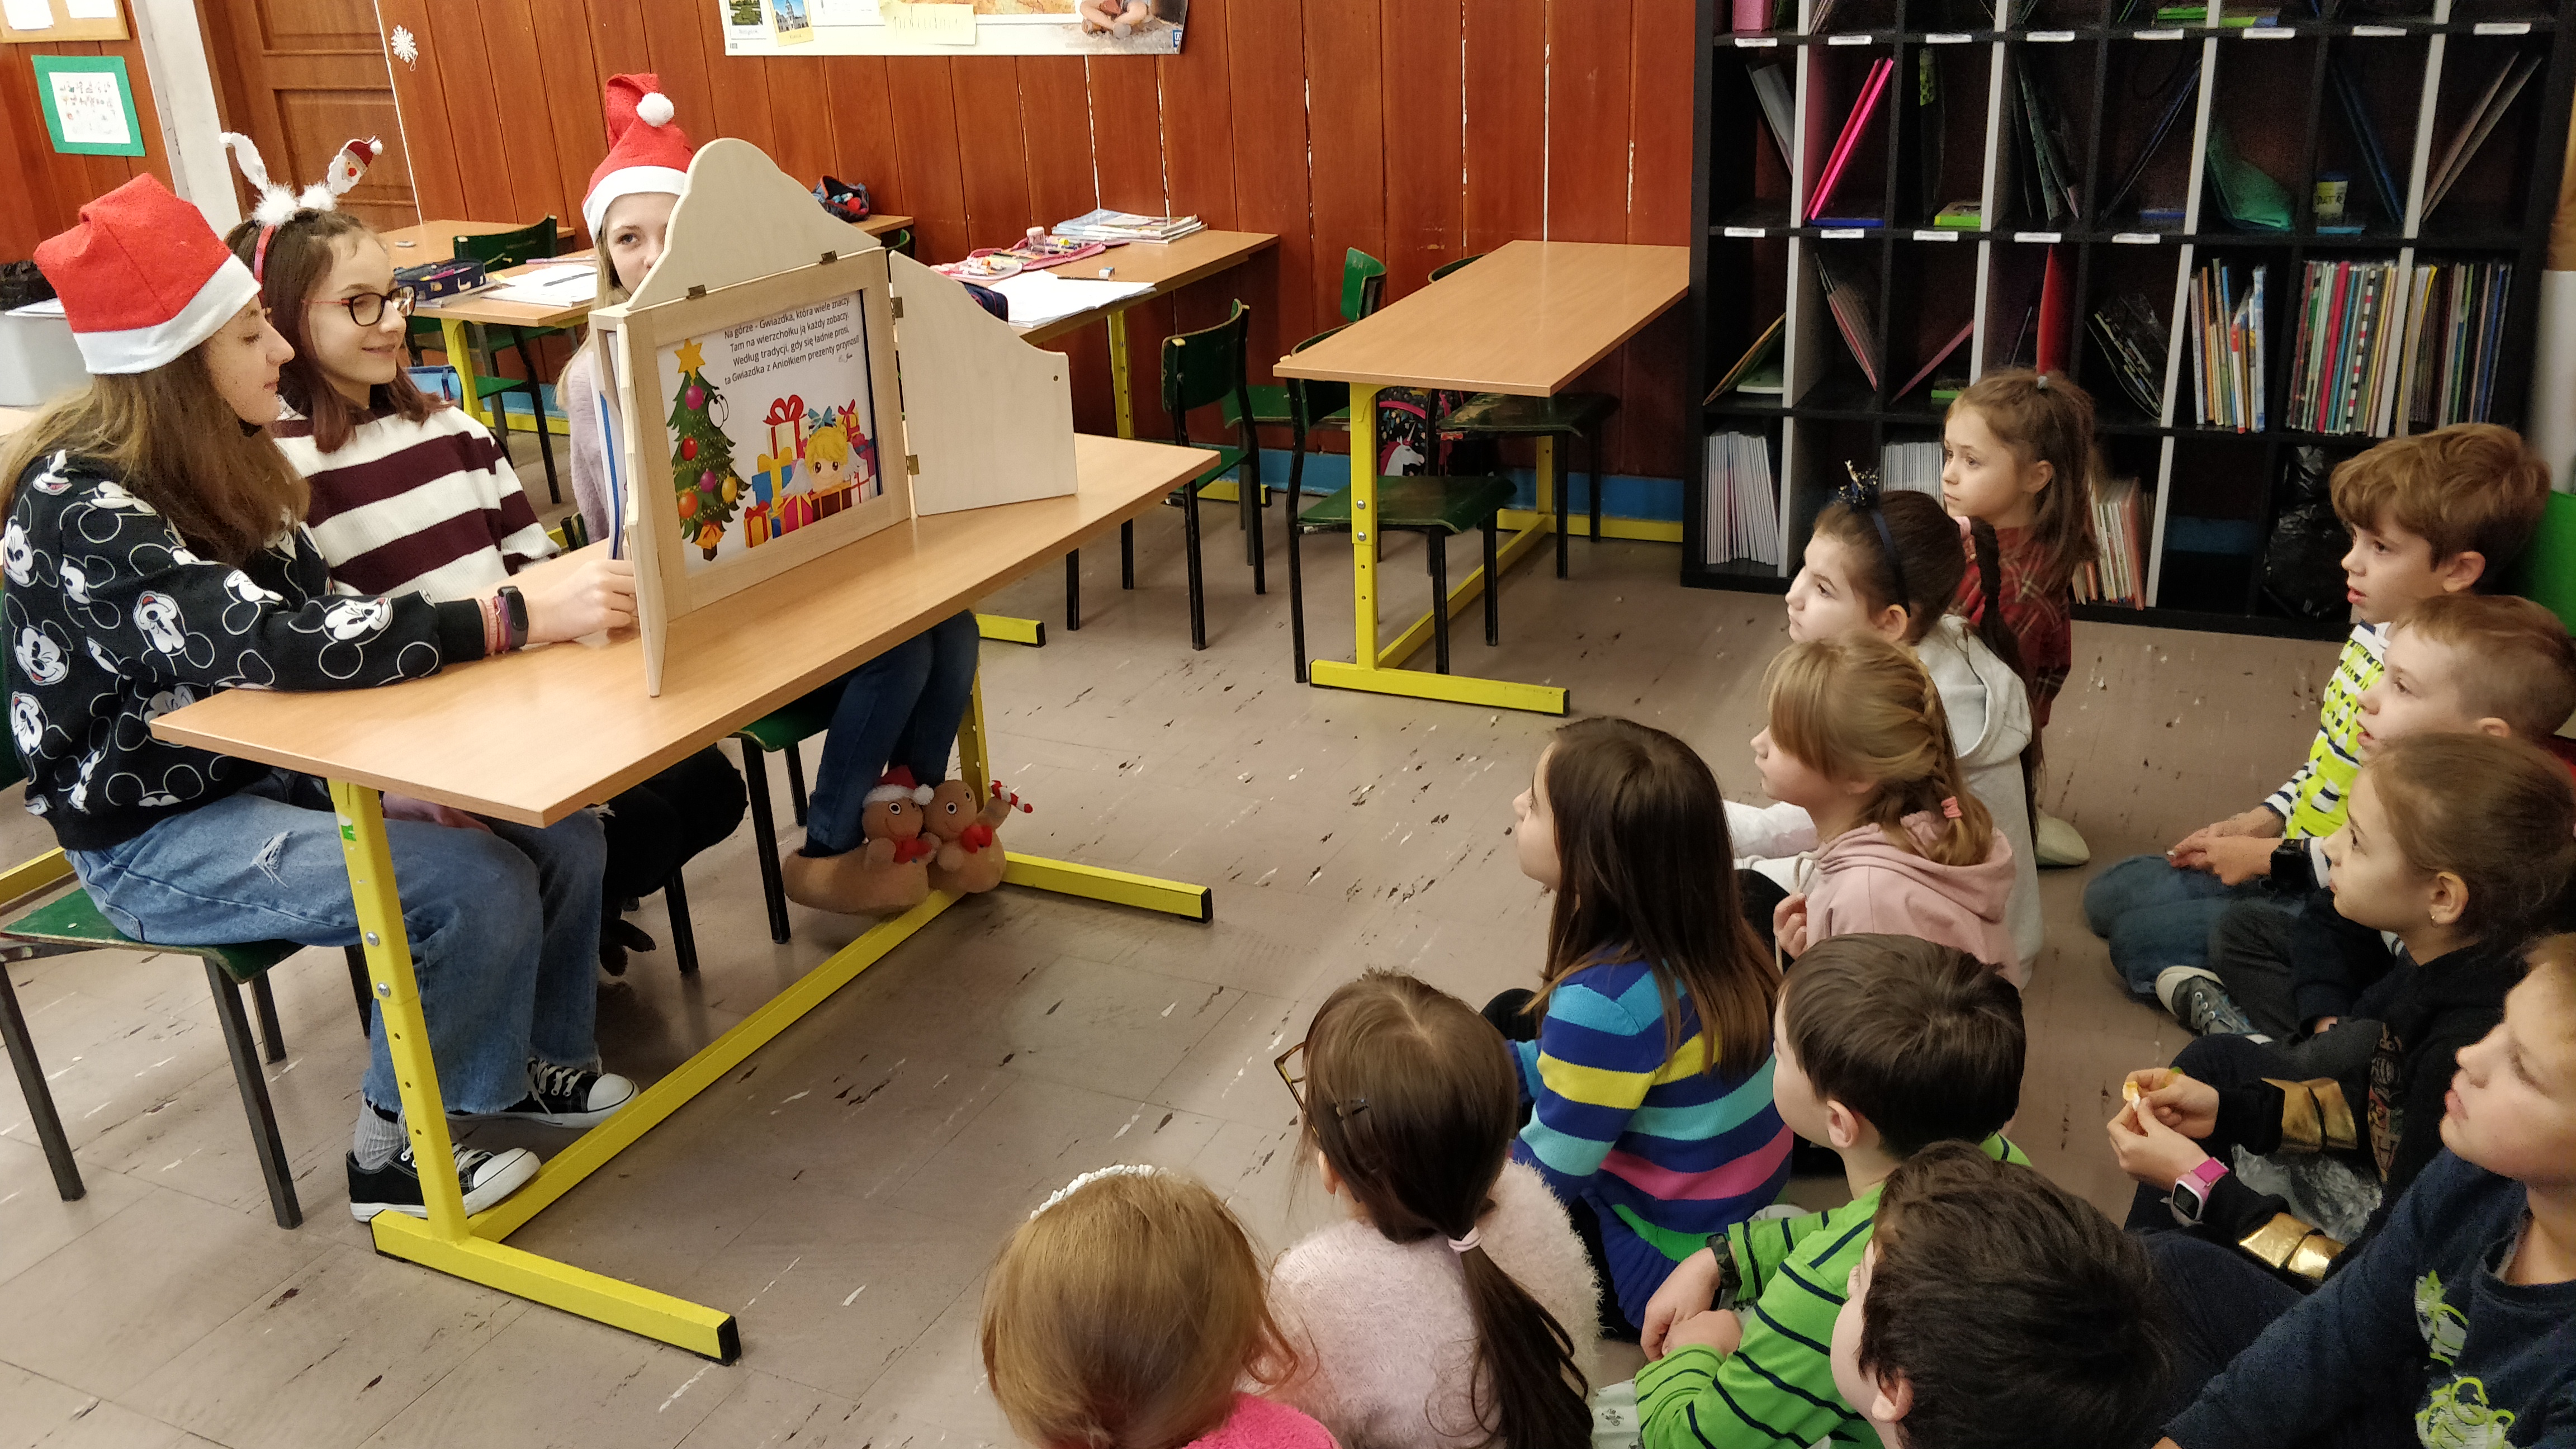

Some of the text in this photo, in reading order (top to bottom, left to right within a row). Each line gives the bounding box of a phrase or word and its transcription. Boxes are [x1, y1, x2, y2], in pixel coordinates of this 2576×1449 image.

[724, 330, 733, 339] Na
[735, 324, 753, 338] górze
[759, 313, 795, 329] Gwiazdka,
[795, 309, 813, 320] która
[814, 302, 831, 314] wiele
[832, 296, 851, 309] znaczy.
[730, 312, 850, 353] Tam na wierzchołku ją każdy zobaczy.
[724, 376, 731, 385] ta
[732, 366, 765, 382] Gwiazdka
[772, 354, 807, 371] Aniołkiem
[808, 345, 835, 362] prezenty
[733, 324, 850, 367] Według tradycji, gdy się ładnie prosi,
